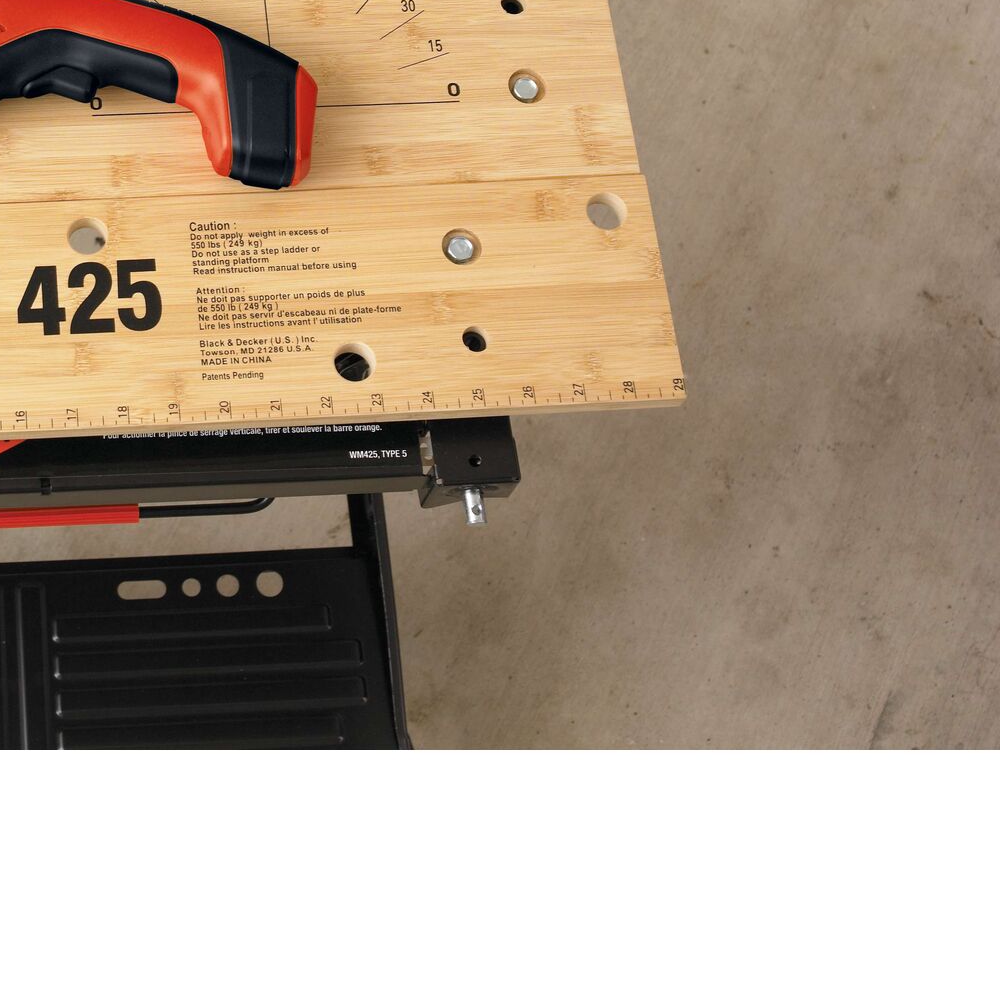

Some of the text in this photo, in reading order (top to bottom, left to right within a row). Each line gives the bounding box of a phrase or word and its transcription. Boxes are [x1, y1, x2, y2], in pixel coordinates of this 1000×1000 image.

[401, 0, 416, 13] 30
[428, 39, 443, 52] 15
[447, 82, 461, 97] 0
[90, 96, 103, 110] 0
[189, 221, 230, 232] Caution
[190, 233, 201, 241] Do
[220, 232, 243, 241] apply
[248, 230, 276, 239] weight
[321, 227, 329, 235] of
[191, 241, 206, 249] 550
[208, 240, 221, 249] lbs
[228, 239, 245, 248] 249
[191, 250, 203, 258] Do
[261, 247, 279, 256] step
[281, 245, 309, 254] ladder
[192, 256, 270, 267] standing platform
[193, 261, 357, 275] Read instruction manual before using
[17, 258, 163, 336] 425
[196, 286, 240, 295] Attention
[197, 296, 208, 304] Ne
[210, 294, 228, 303] doit
[230, 295, 246, 305] pas
[248, 292, 291, 302] supporter
[307, 290, 331, 300] poids
[334, 290, 344, 298] de
[347, 289, 366, 298] plus
[197, 302, 273, 313] de 550 lb 249 kg
[198, 313, 210, 321] Ne
[212, 312, 229, 321] doit
[231, 313, 247, 322] pas
[250, 311, 275, 319] servir
[328, 307, 337, 315] ni
[339, 307, 350, 315] de
[352, 305, 402, 315] plate-forme
[199, 322, 216, 331] Lire
[218, 321, 231, 330] les
[233, 319, 285, 329] instructions
[287, 318, 311, 326] avant
[319, 315, 362, 325] utilisation
[199, 339, 225, 348] Black
[236, 338, 267, 346] Decker
[240, 347, 255, 355] MD
[257, 345, 284, 354] 21286
[201, 358, 228, 366] MADE
[241, 356, 272, 364] CHINA
[202, 370, 264, 381] Patents Pending
[16, 410, 26, 423] 16
[66, 408, 77, 421] 17
[118, 405, 129, 419] 18
[169, 403, 180, 416] 19
[220, 400, 230, 414] 20
[271, 399, 281, 412] 21
[321, 396, 332, 409] 22
[372, 393, 382, 406] 23
[422, 391, 433, 404] 24
[473, 388, 483, 401] 25
[523, 386, 534, 399] 26
[573, 383, 584, 396] 27
[622, 380, 634, 394] 28
[672, 378, 684, 391] 29
[283, 426, 290, 434] et
[291, 425, 323, 434] soulever
[324, 425, 332, 433] la
[333, 424, 353, 432] barre
[381, 450, 400, 458] TYPE
[401, 450, 408, 458] 5
